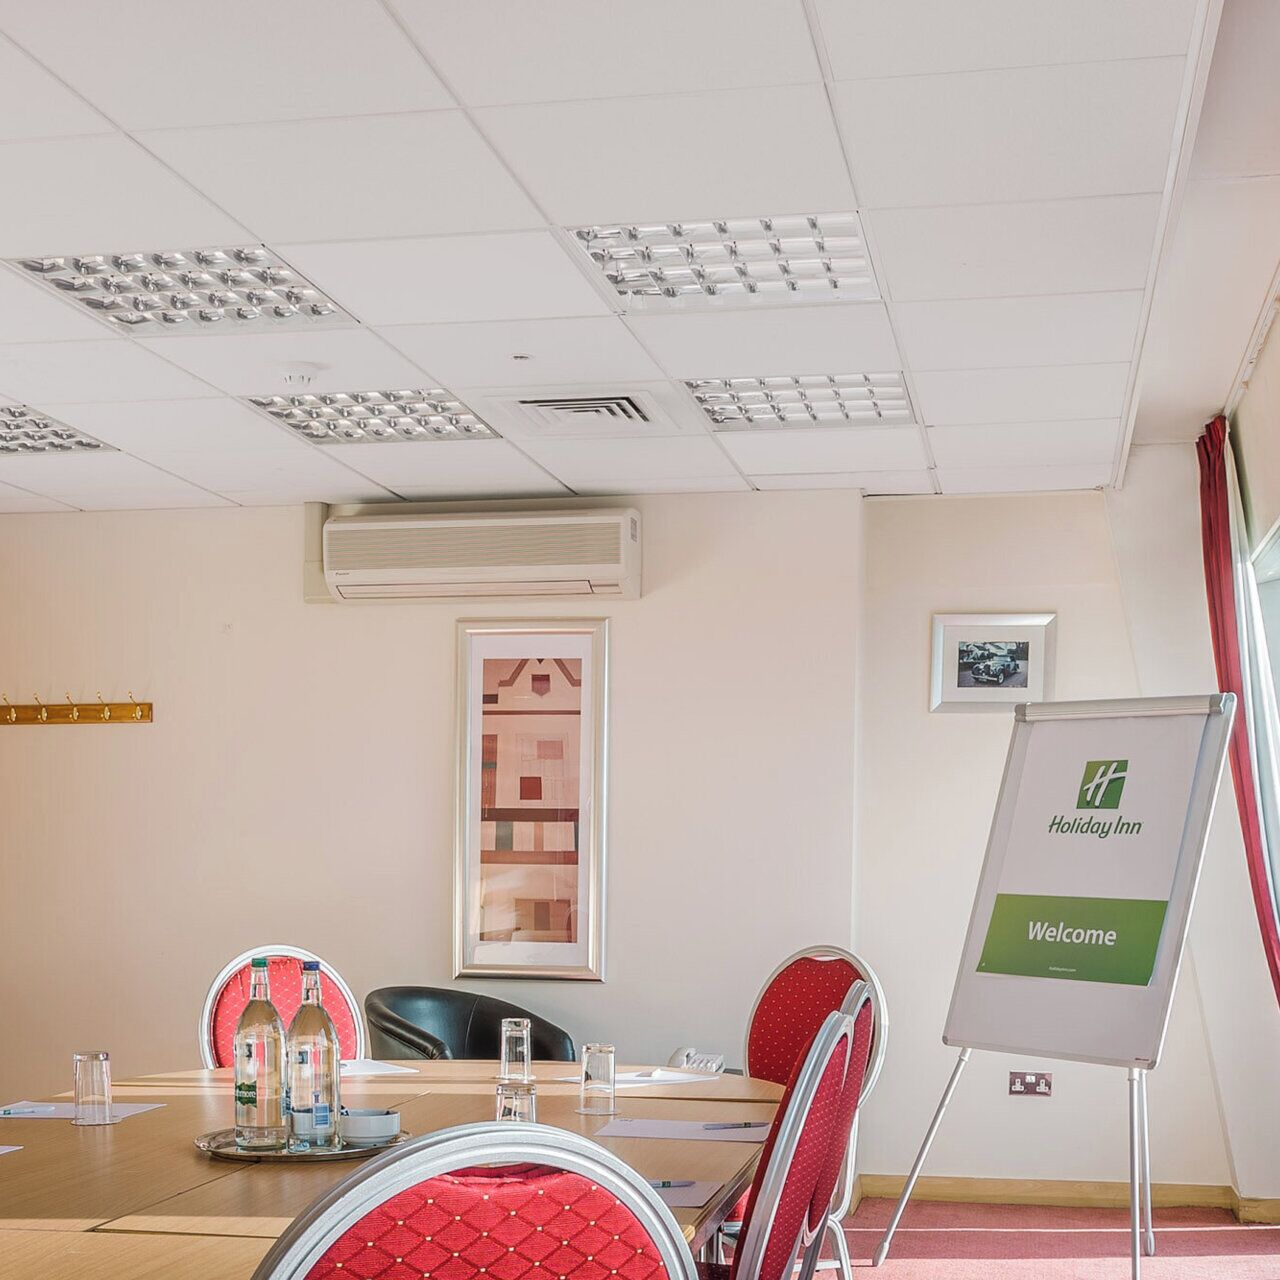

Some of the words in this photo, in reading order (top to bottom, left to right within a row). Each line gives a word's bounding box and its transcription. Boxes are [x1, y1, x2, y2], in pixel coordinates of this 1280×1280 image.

[1048, 815, 1113, 839] Holiday
[1113, 815, 1142, 834] Inn
[1028, 921, 1117, 946] Welcome
